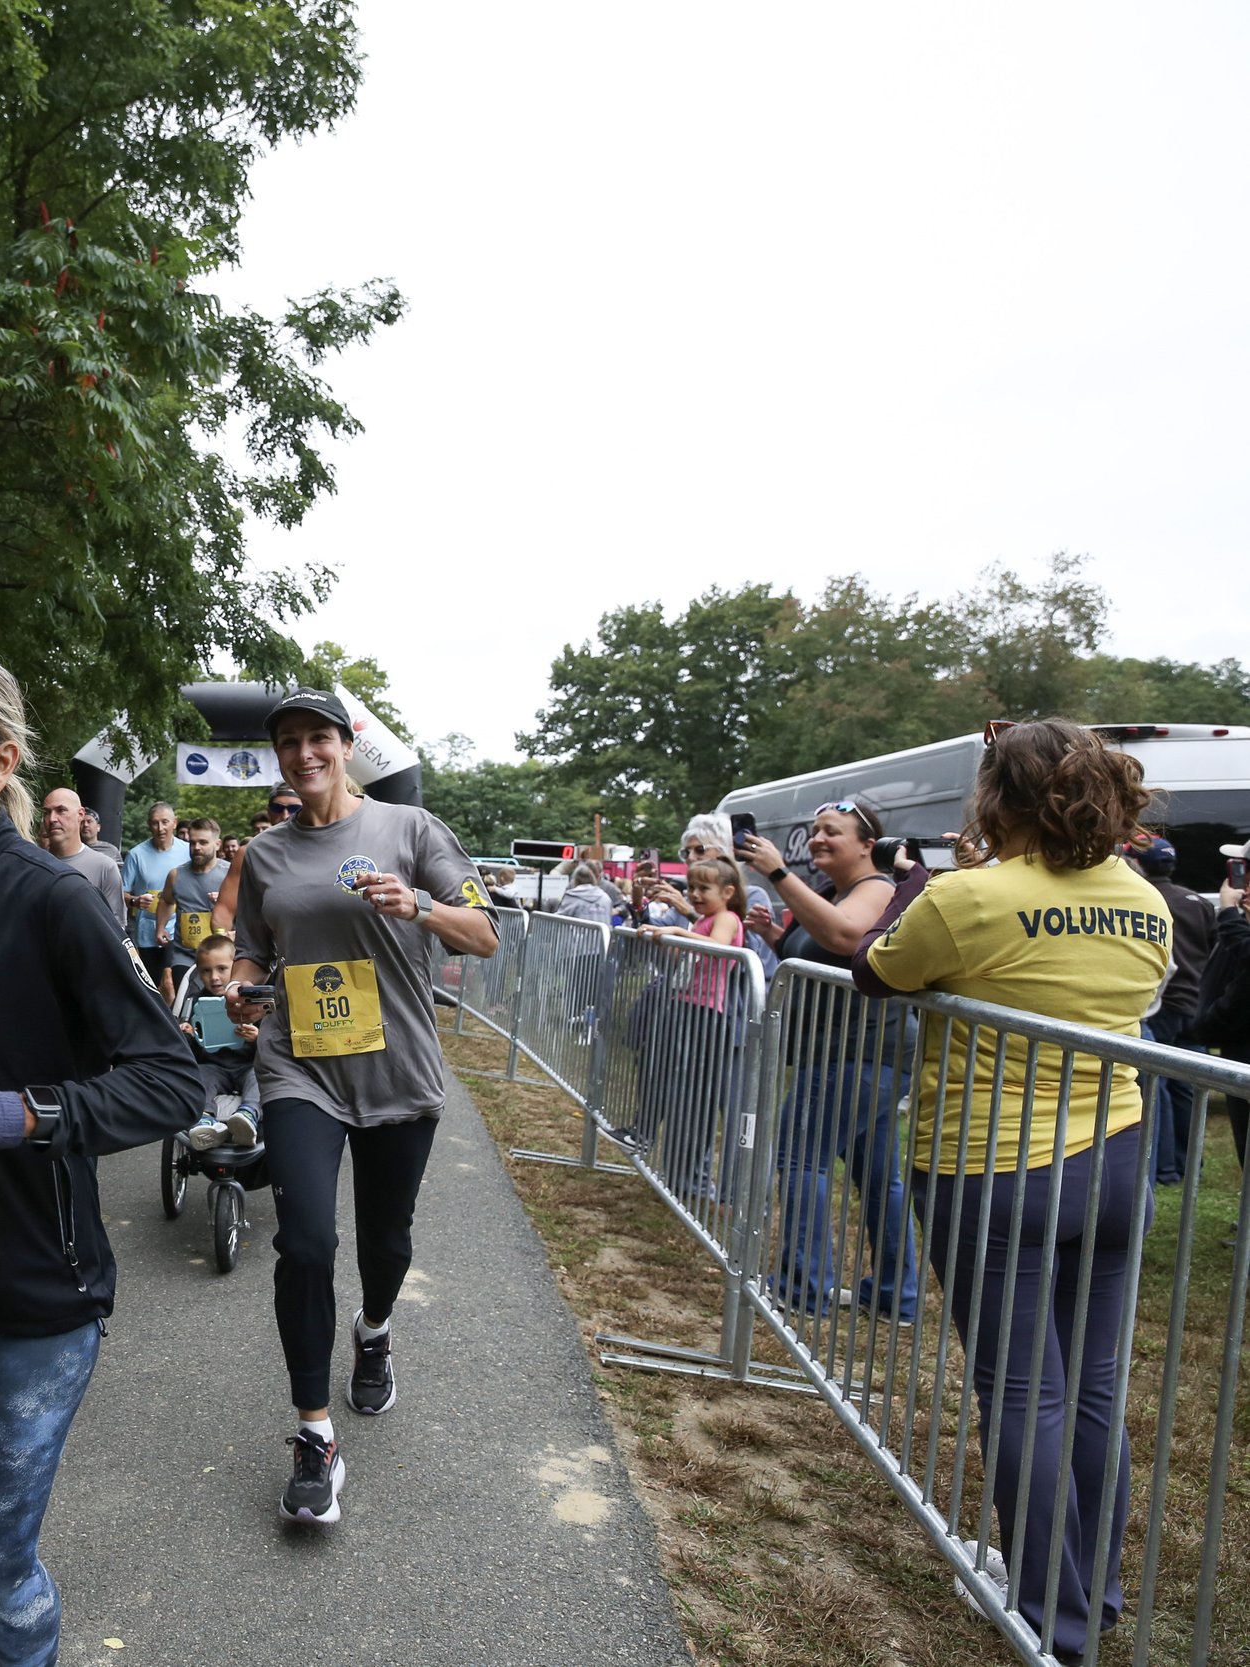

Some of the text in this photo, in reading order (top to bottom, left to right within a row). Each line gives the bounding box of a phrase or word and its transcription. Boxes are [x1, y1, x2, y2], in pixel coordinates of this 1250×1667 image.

[188, 926, 201, 935] 238
[1017, 906, 1167, 947] VOLUNTEER
[316, 996, 350, 1020] 150
[322, 1019, 355, 1028] DUFFY
